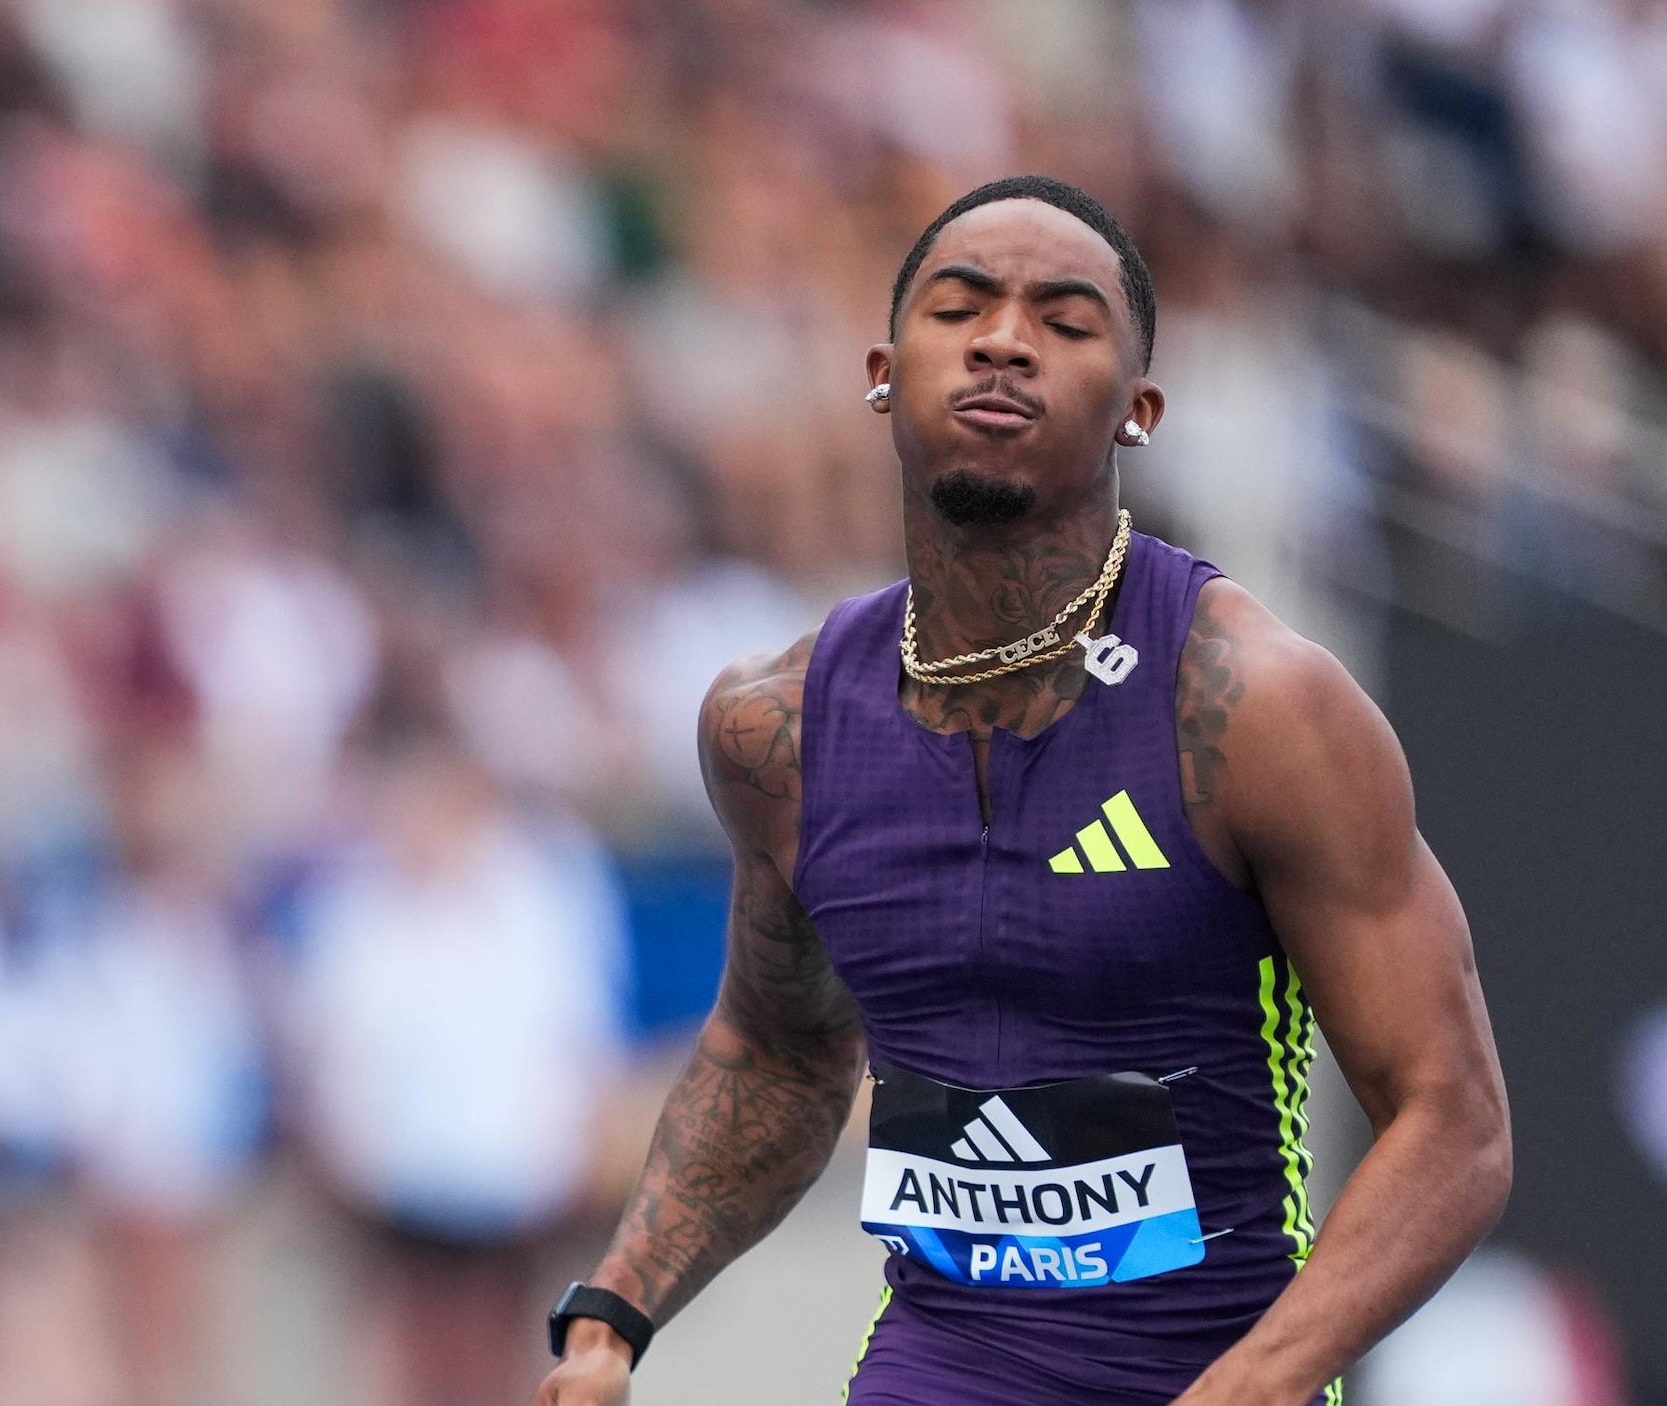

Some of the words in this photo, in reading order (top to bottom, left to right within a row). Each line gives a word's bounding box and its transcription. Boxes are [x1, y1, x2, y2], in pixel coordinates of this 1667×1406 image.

[999, 626, 1061, 664] CECE
[889, 1163, 1156, 1225] ANTHONY
[970, 1242, 1109, 1282] PARIS
